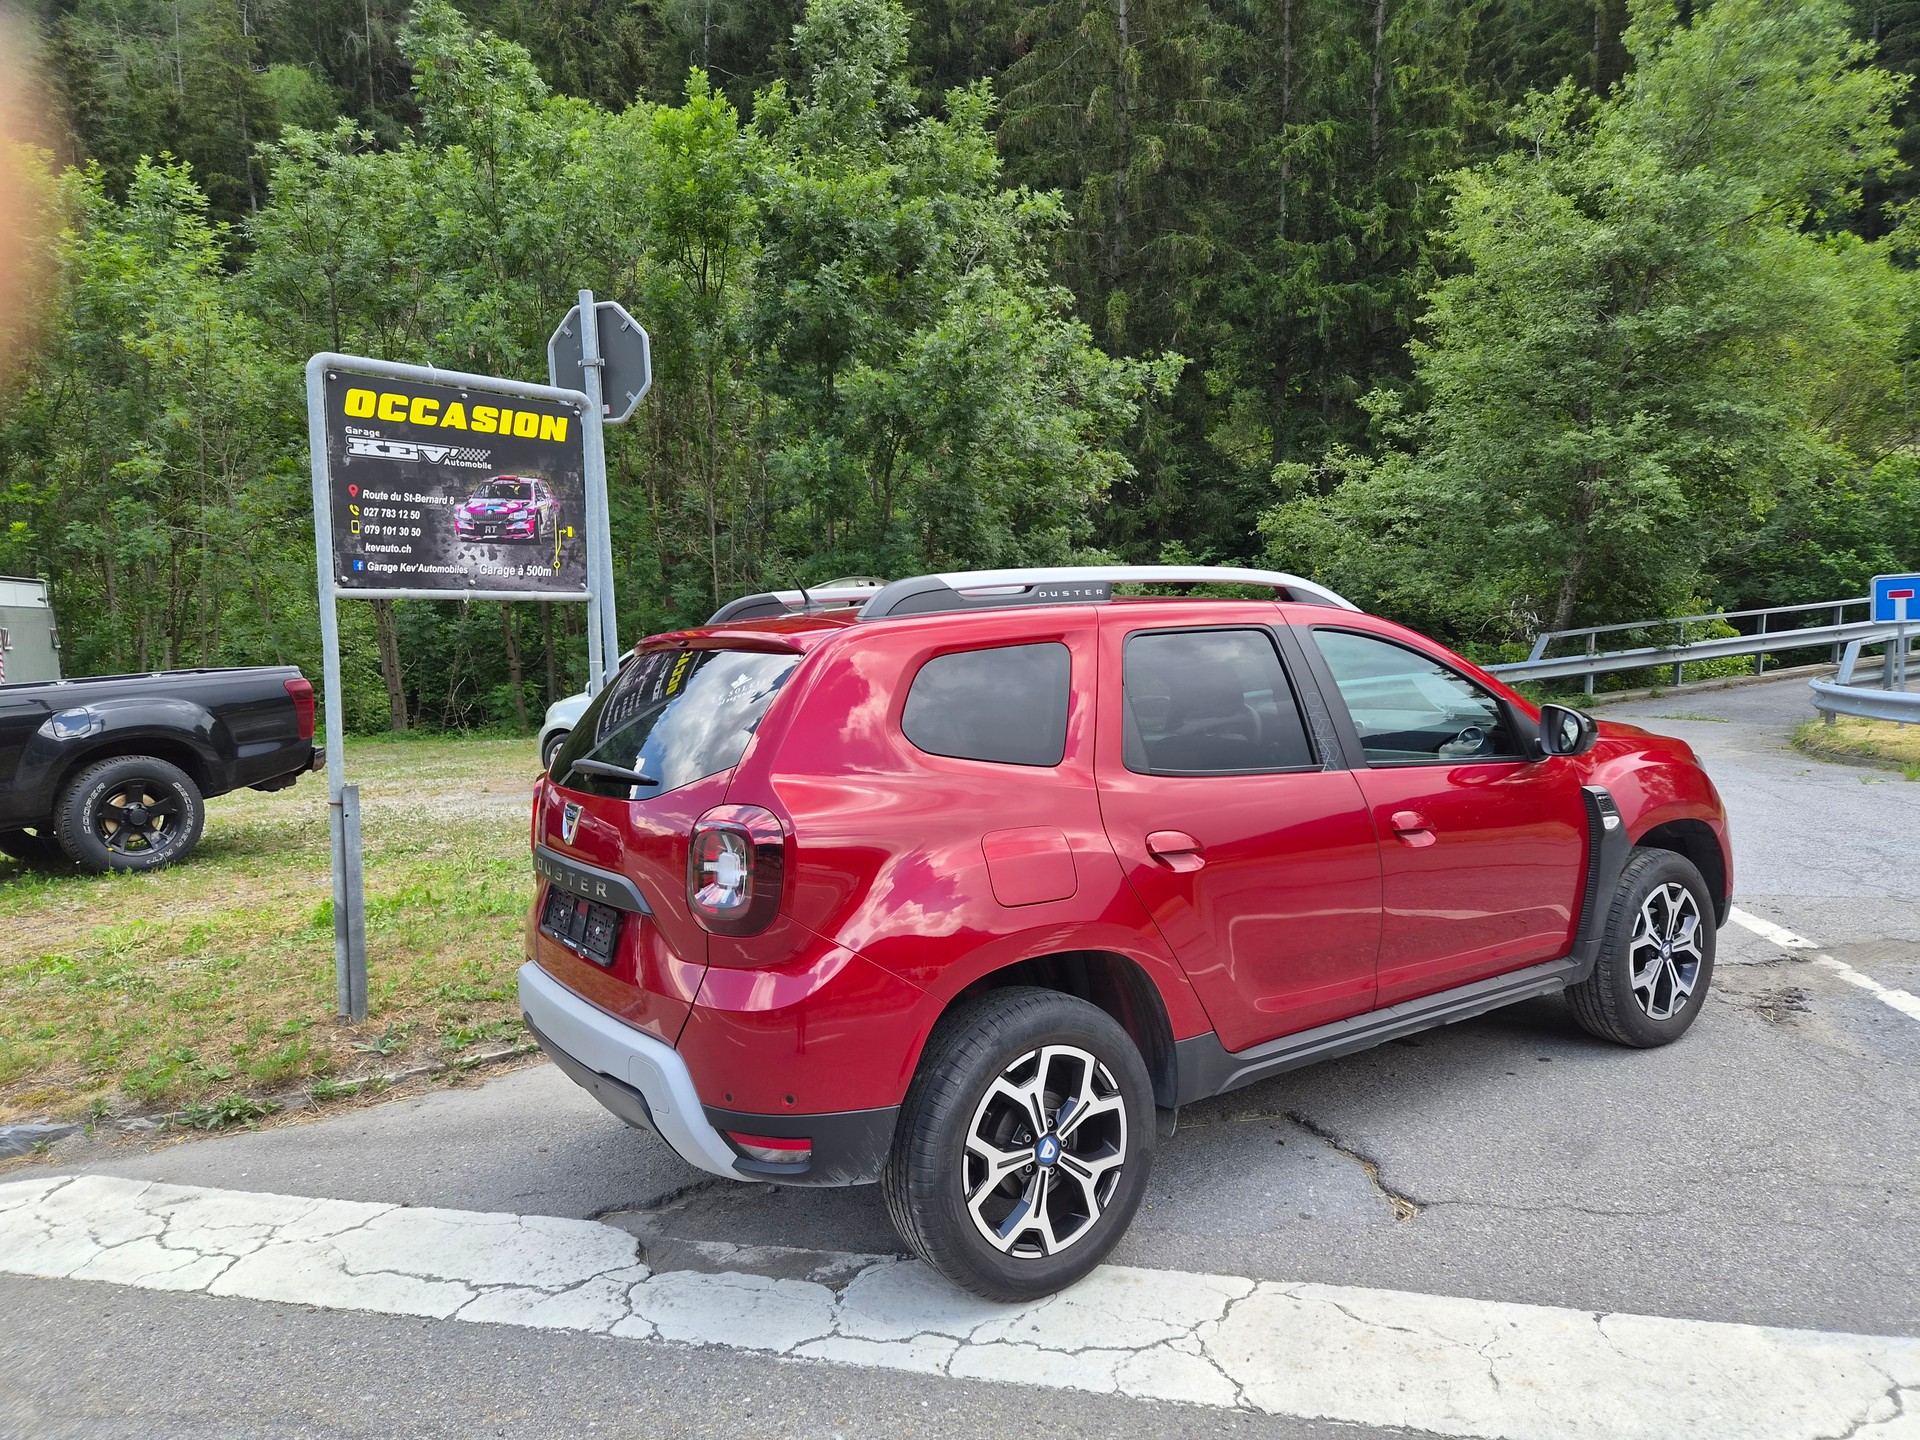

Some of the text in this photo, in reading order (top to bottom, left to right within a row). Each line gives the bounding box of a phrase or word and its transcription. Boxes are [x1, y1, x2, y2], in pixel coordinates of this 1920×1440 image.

[344, 388, 568, 442] OCCASION
[345, 426, 380, 438] Garage
[444, 458, 492, 470] Automobile
[362, 489, 455, 505] Route du St-Bernard 8
[363, 507, 421, 520] 027 783 12 50
[364, 525, 422, 537] 079 101 30 50
[484, 525, 497, 534] RT
[365, 543, 412, 554] kevauto.ch
[367, 562, 469, 575] Garage Kev'Automobiles
[479, 564, 552, 577] Garage à 500m
[1039, 589, 1104, 598] DUSTER
[82, 782, 106, 834] COOPER
[172, 782, 194, 847] DISCOVERER
[537, 857, 607, 898] DUSTER
